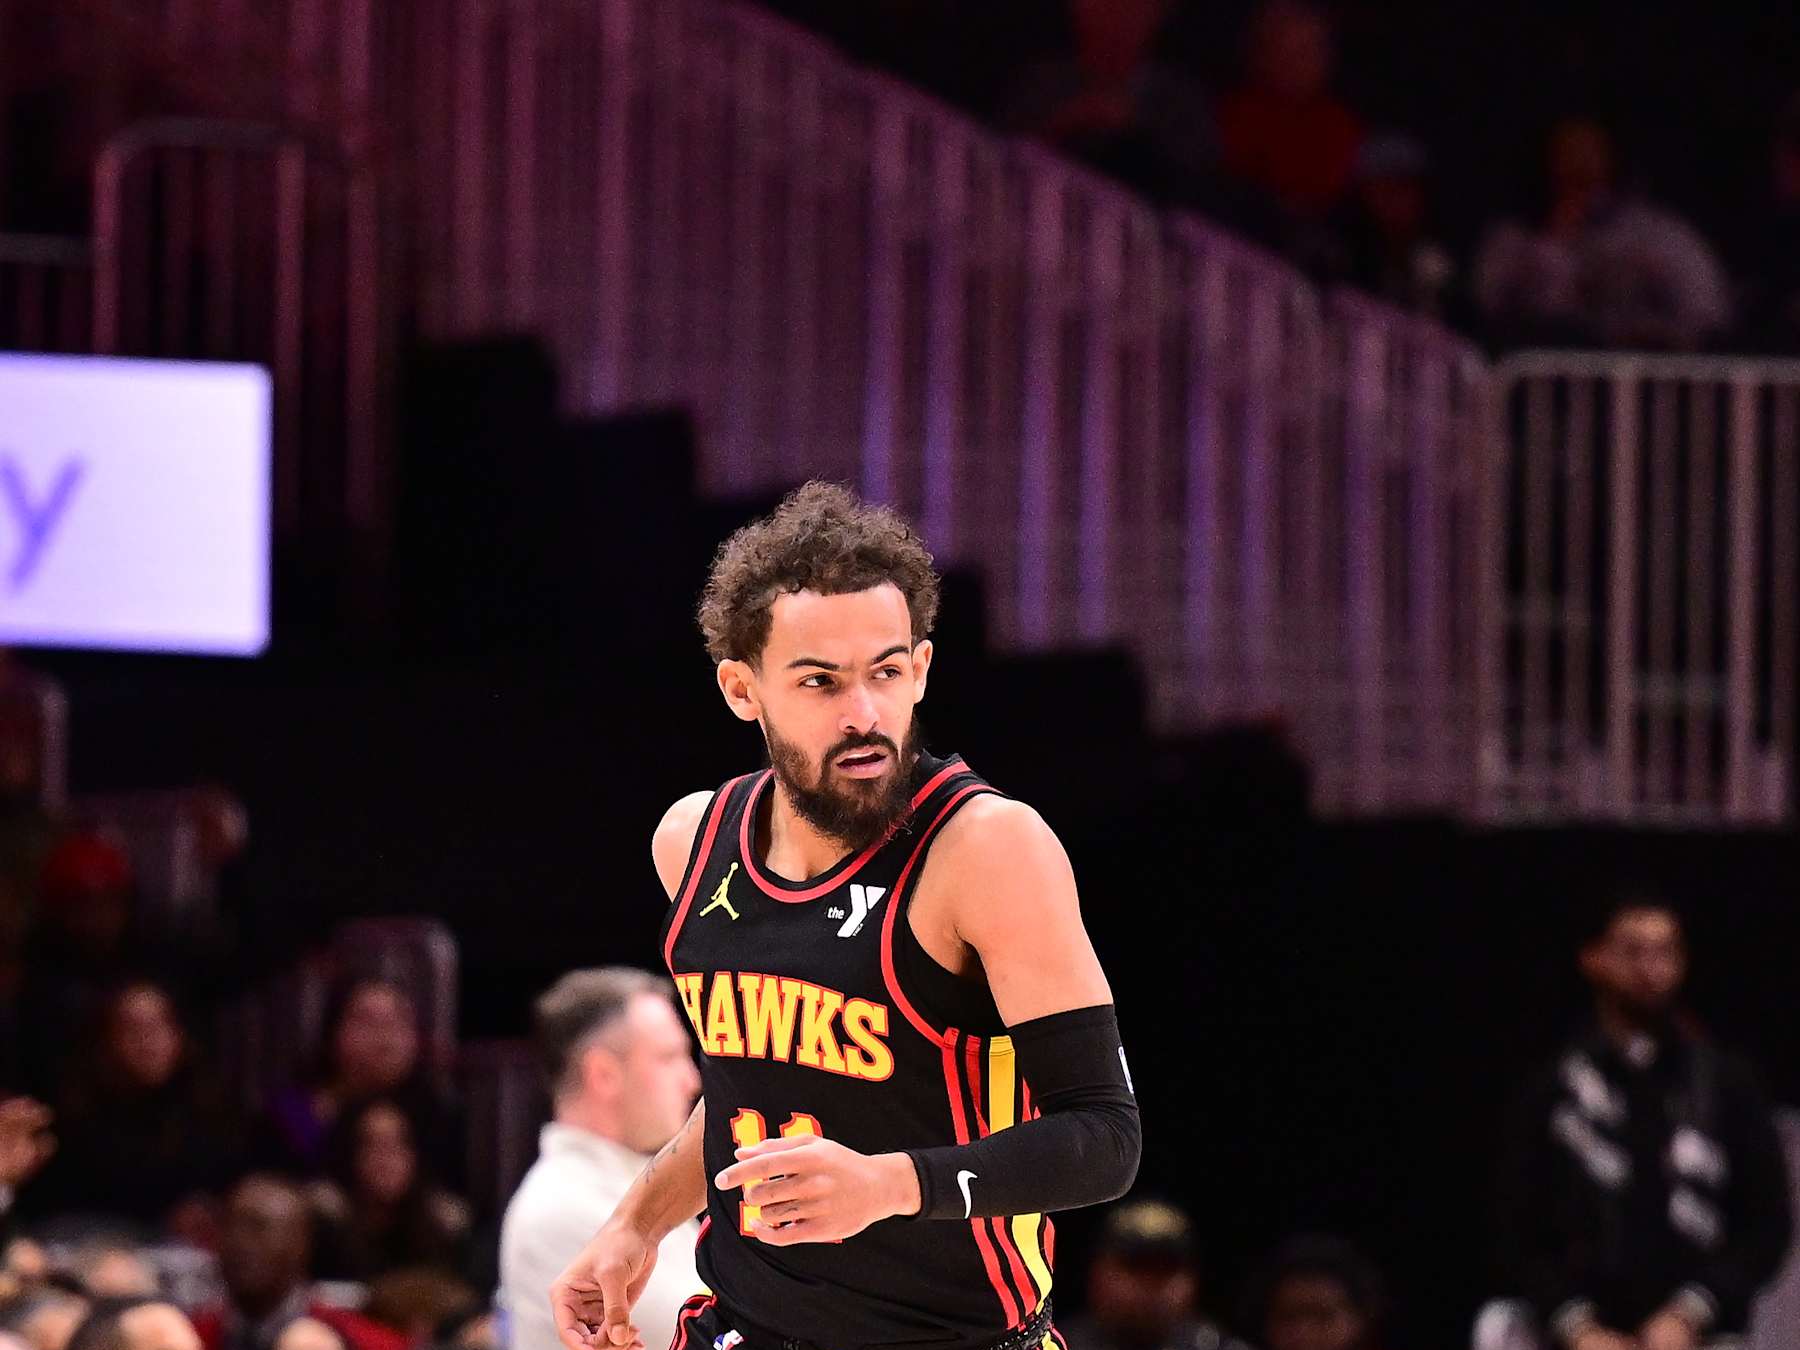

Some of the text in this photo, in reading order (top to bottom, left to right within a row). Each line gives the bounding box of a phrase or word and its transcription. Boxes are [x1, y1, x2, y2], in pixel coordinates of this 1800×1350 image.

[827, 906, 845, 919] the
[836, 884, 887, 938] Y
[672, 970, 895, 1082] HAWKS
[729, 1107, 843, 1244] 1
